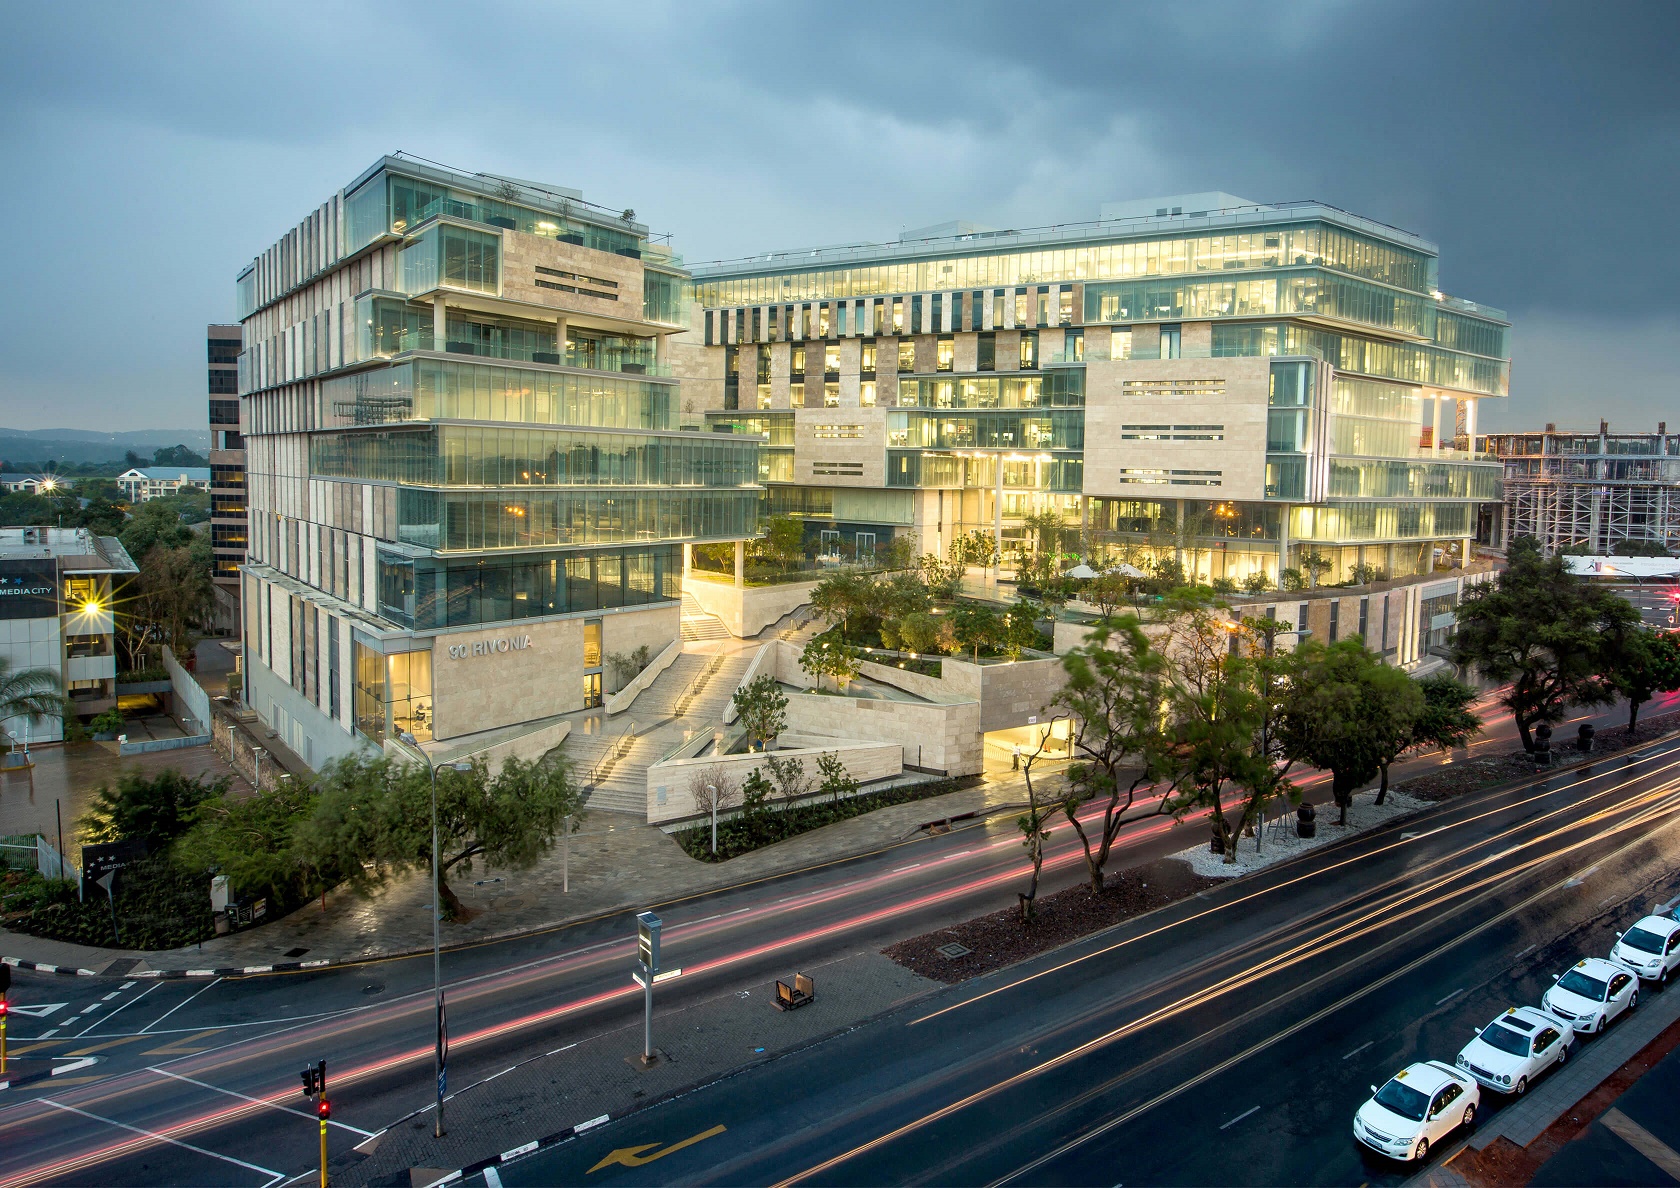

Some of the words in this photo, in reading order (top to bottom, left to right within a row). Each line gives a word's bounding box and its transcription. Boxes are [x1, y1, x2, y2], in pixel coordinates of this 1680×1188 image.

[449, 643, 468, 660] 90
[472, 634, 534, 657] RIVONIA
[100, 862, 126, 871] MEDIA
